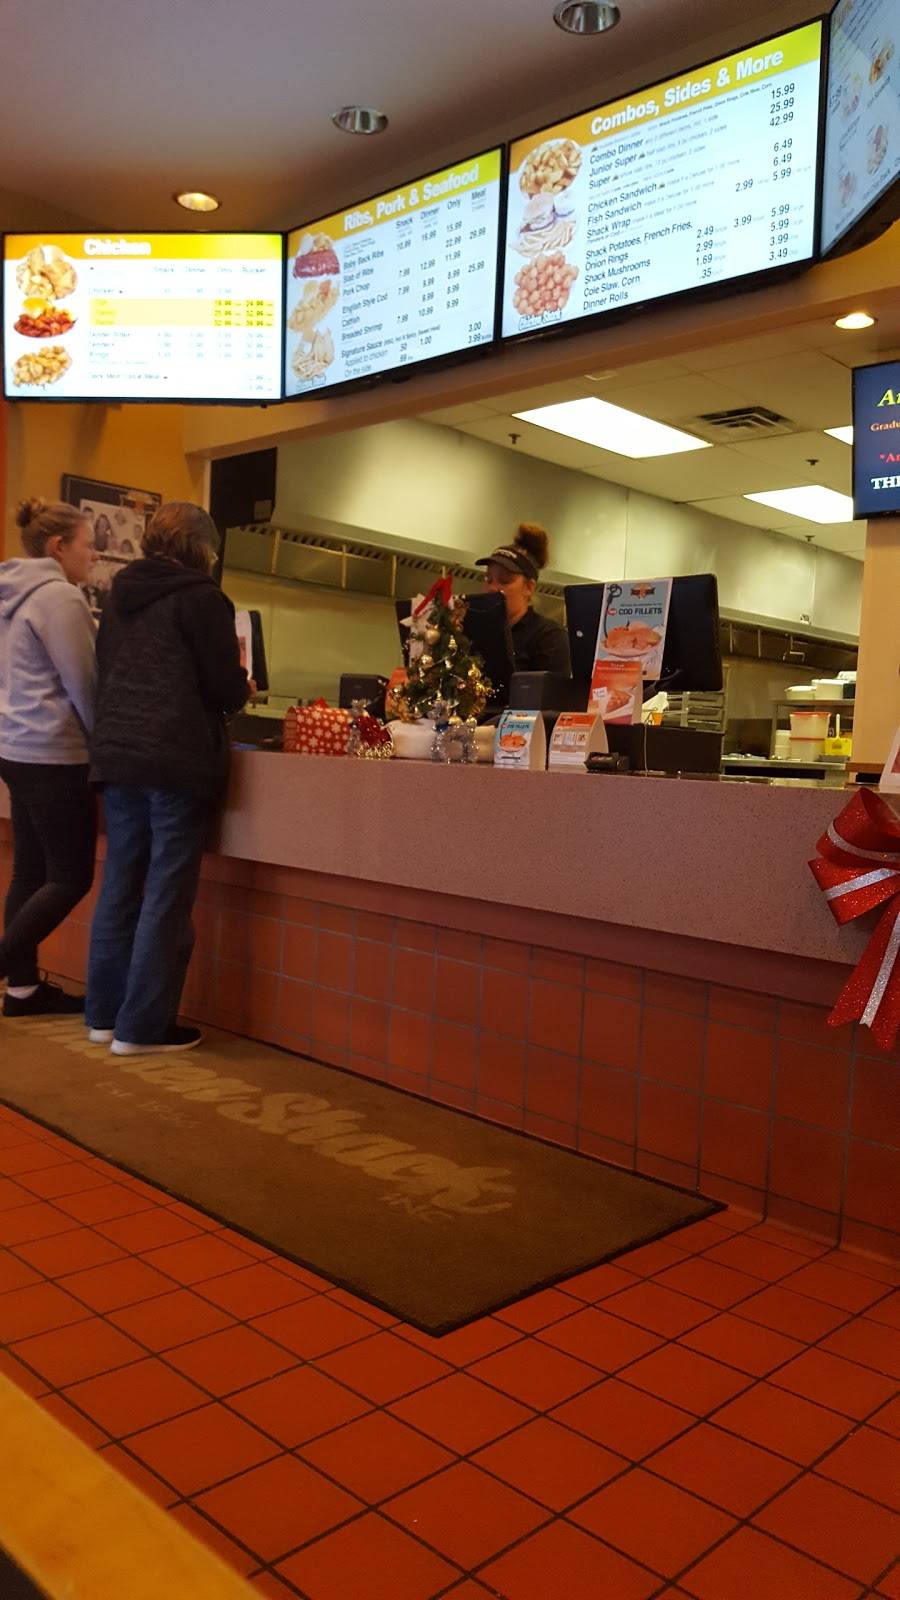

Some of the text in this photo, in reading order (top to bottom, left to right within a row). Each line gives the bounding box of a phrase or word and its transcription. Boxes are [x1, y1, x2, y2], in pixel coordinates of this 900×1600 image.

[590, 147, 617, 165] Combo
[618, 139, 644, 155] Dinner
[771, 82, 795, 99] 15.99
[592, 100, 660, 135] Combos,
[664, 81, 711, 108] Sides
[717, 67, 731, 88] &
[736, 50, 784, 81] More
[589, 161, 613, 178] Junior
[615, 154, 638, 168] Super
[770, 97, 795, 114] 25.99
[589, 176, 611, 190] Super
[769, 111, 794, 127] 42.99
[773, 138, 793, 152] 6.49
[344, 211, 374, 233] Ribs,
[376, 194, 406, 219] Pork
[409, 188, 420, 206] &
[422, 163, 480, 201] Seafood
[586, 223, 609, 239] Shack
[611, 218, 631, 231] Wrap
[735, 178, 754, 193] 2.99
[587, 213, 604, 226] Fish
[605, 201, 642, 221] Sandwich
[772, 167, 792, 181] 5.99
[588, 195, 618, 213] Chicken
[619, 183, 657, 203] Sandwich
[773, 152, 792, 167] 6.49
[84, 238, 152, 256] Chicken
[583, 285, 600, 298] Cole
[621, 275, 640, 288] Corn
[696, 253, 713, 267] 1.69
[769, 232, 789, 247] 3.99
[584, 272, 606, 285] Shack
[607, 258, 651, 277] Mushrooms
[696, 239, 713, 253] 2.99
[770, 218, 789, 232] 5.99
[585, 259, 607, 272] Onion
[608, 252, 629, 265] Rings
[697, 225, 714, 239] 2.49
[733, 214, 752, 229] 3.99
[771, 203, 790, 218] 5.99
[585, 245, 608, 260] Shack
[608, 236, 642, 253] Potatoes,
[643, 226, 671, 242] French
[583, 297, 607, 311] Dinner
[609, 290, 629, 303] Rolls
[769, 247, 788, 261] 3.49
[467, 320, 481, 333] 3.00
[618, 608, 633, 616] COD
[634, 606, 663, 616] FILLETS
[215, 1091, 517, 1214] Shack
